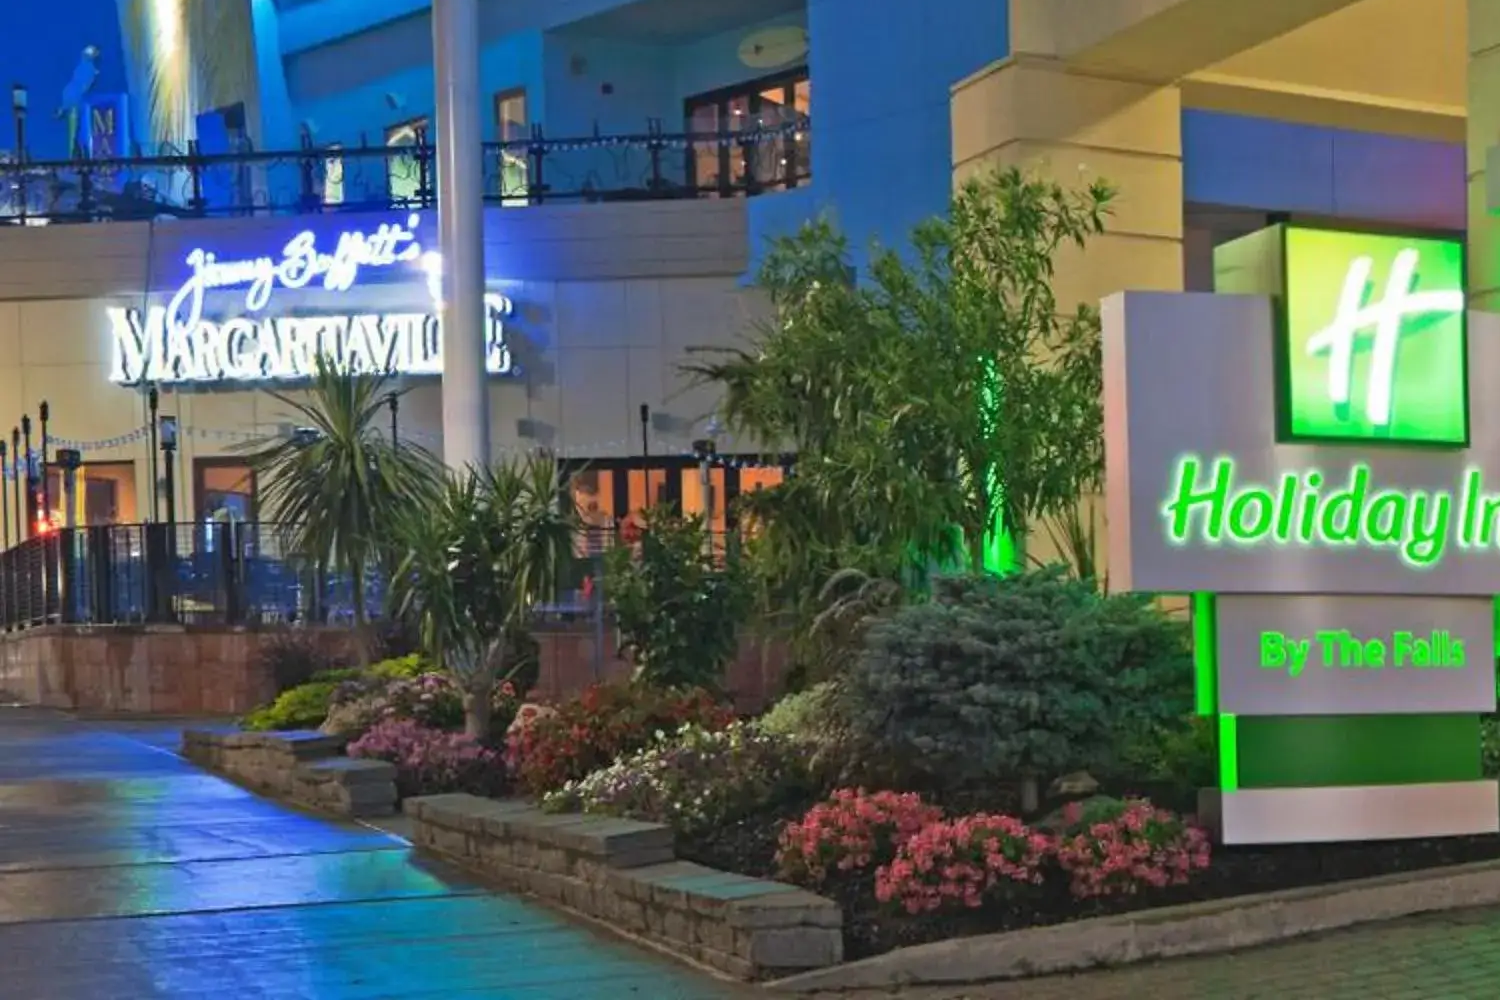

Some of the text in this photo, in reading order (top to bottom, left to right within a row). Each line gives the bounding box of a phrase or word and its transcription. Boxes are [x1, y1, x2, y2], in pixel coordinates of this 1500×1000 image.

[106, 293, 514, 385] MARGARITAVILE
[1166, 457, 1450, 567] Holiday
[1260, 630, 1466, 676] By The Falls
